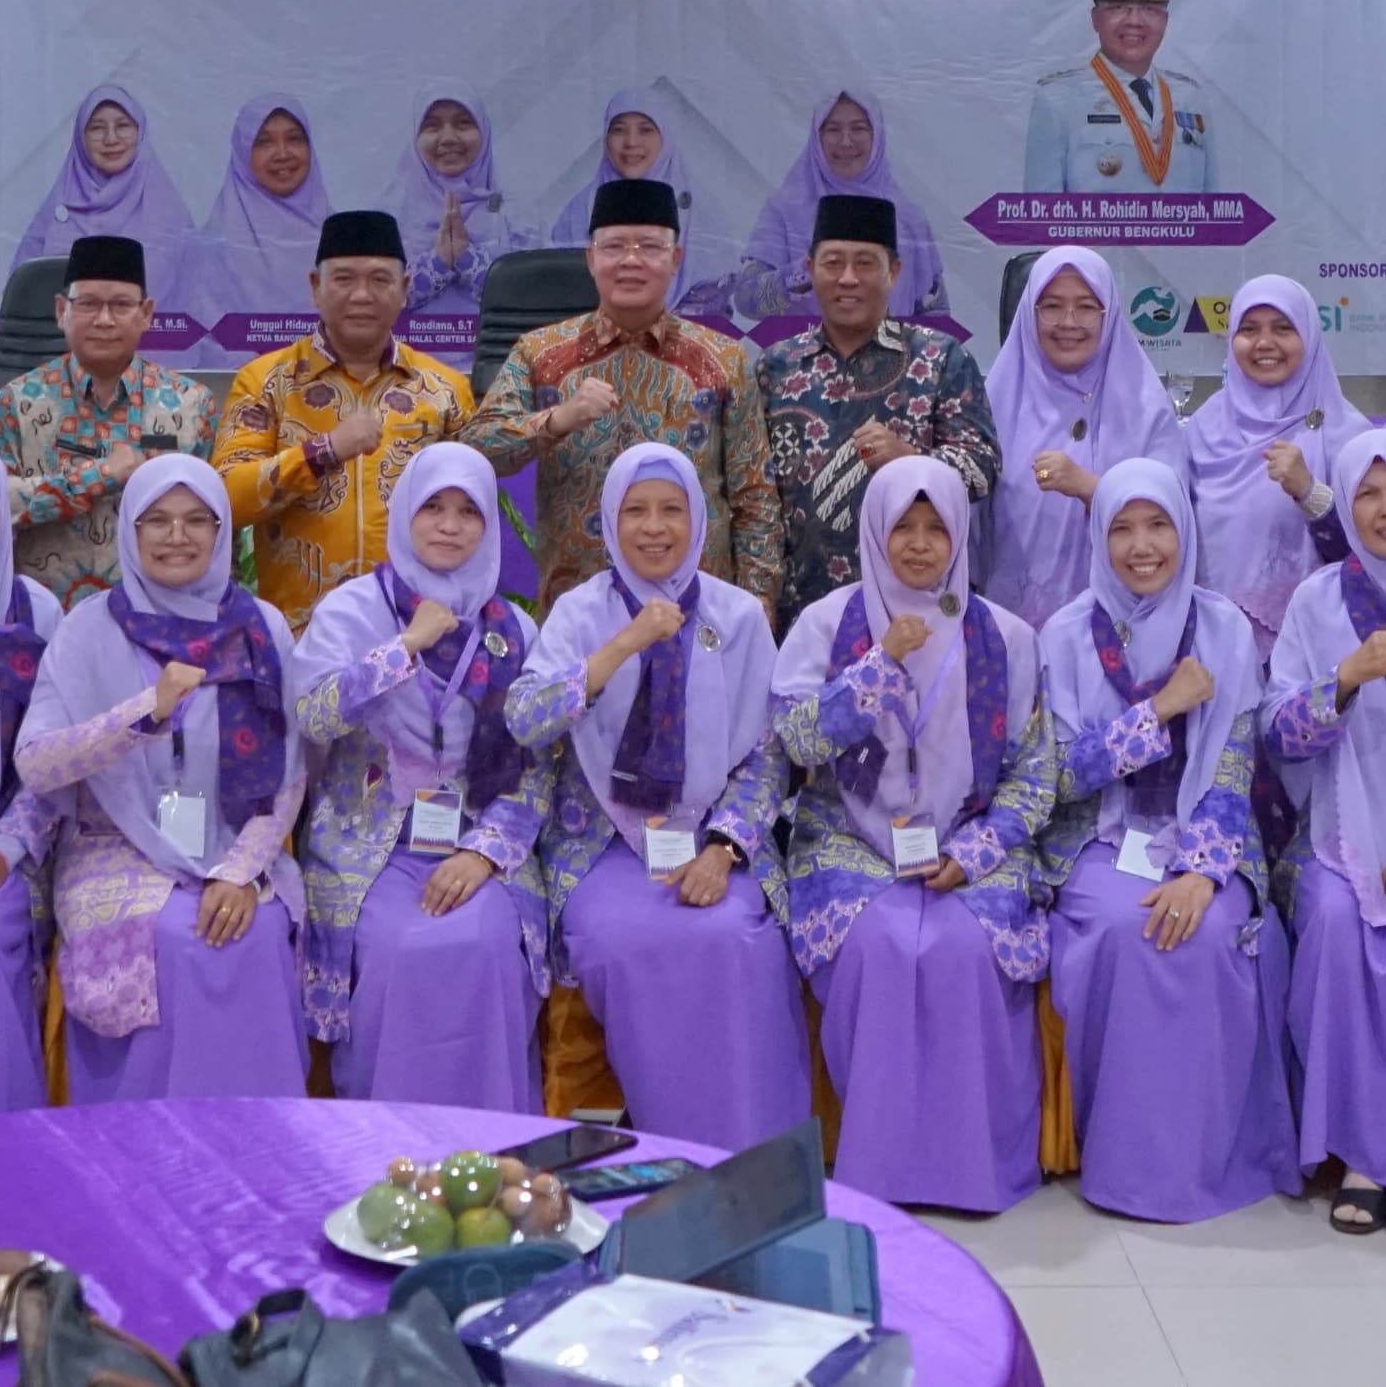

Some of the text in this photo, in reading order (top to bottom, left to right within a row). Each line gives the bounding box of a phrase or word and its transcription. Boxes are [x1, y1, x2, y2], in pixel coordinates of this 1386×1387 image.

[997, 200, 1244, 222] Prof. Dr. drh. H. Rohidin Mersyah, MMA
[1048, 226, 1195, 238] GUBERNUR BENGKULU
[250, 319, 319, 332] Unggul Hidaya
[246, 334, 273, 343] KETUA
[409, 335, 434, 343] HALAL
[435, 335, 466, 343] CENTER
